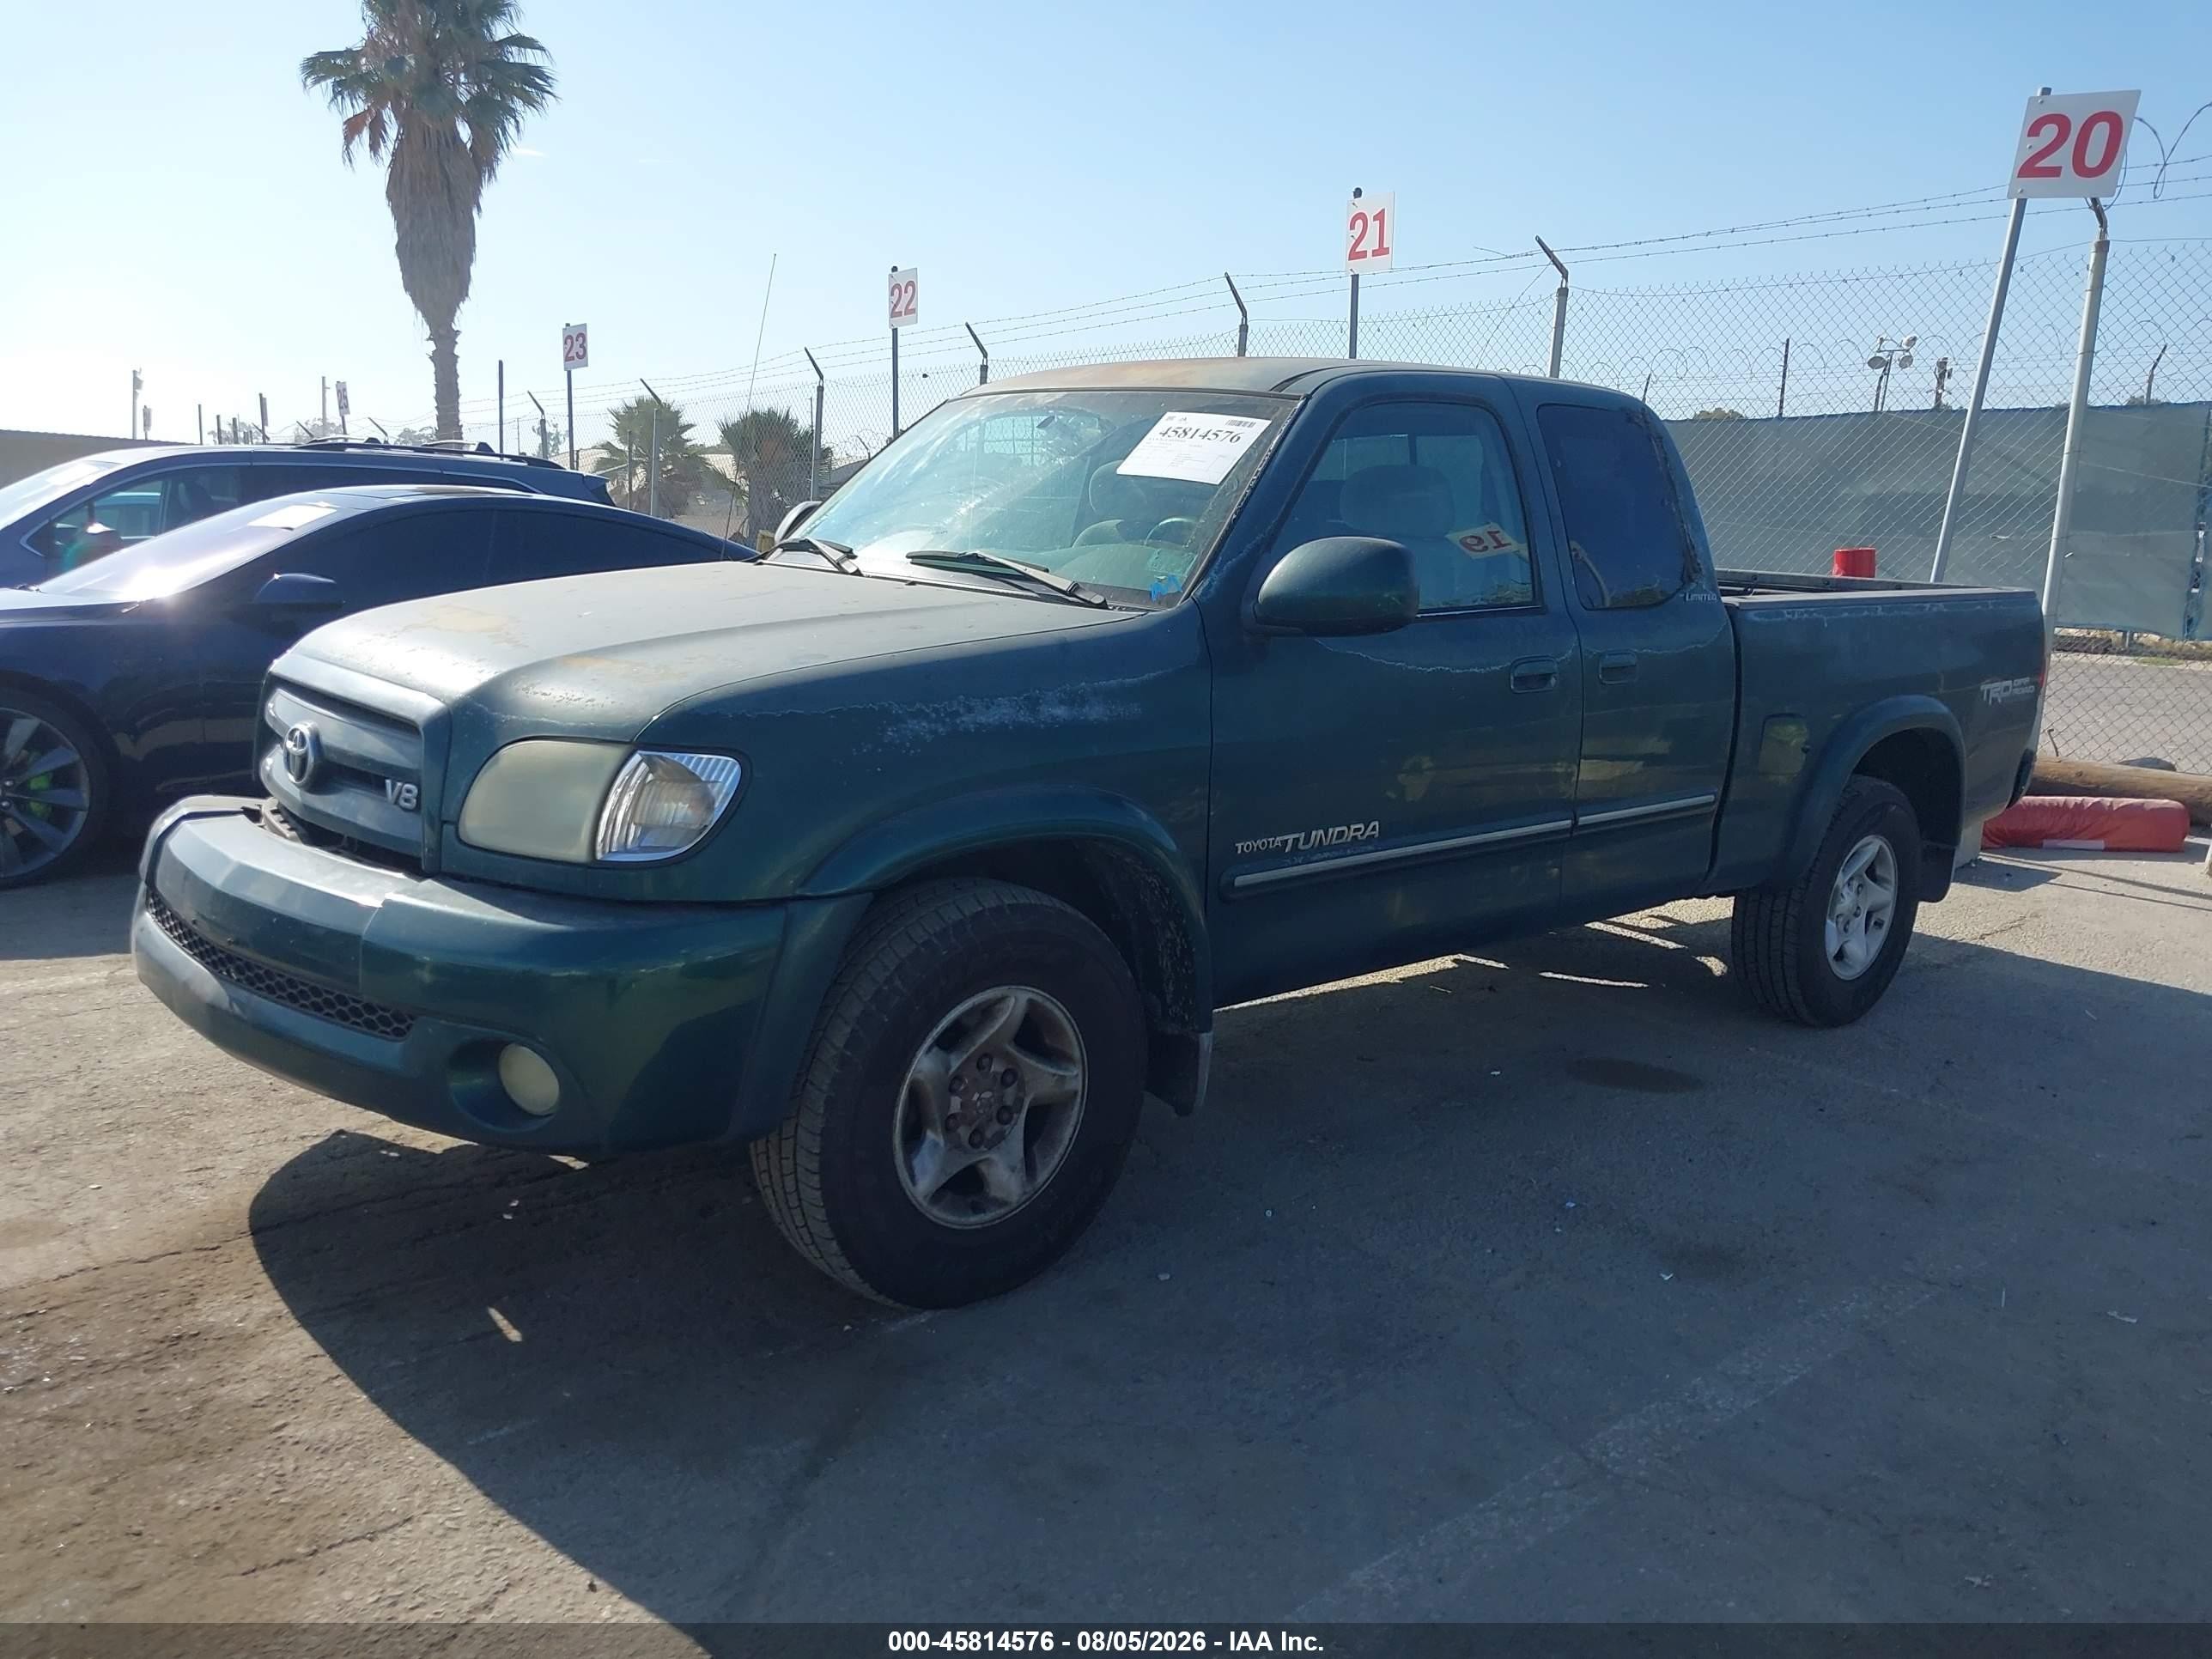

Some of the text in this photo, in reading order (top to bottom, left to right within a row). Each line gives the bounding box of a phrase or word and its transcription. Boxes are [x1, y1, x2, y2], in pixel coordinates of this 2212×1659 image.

[2017, 111, 2124, 179] 20
[1348, 208, 1389, 261] 21
[890, 280, 916, 319] 22
[564, 331, 587, 362] 23
[1159, 426, 1243, 443] 45814576
[1980, 680, 2013, 705] TRD
[385, 779, 418, 810] V8
[1235, 837, 1282, 854] TOYOTA
[1278, 820, 1380, 853] TUNDRA
